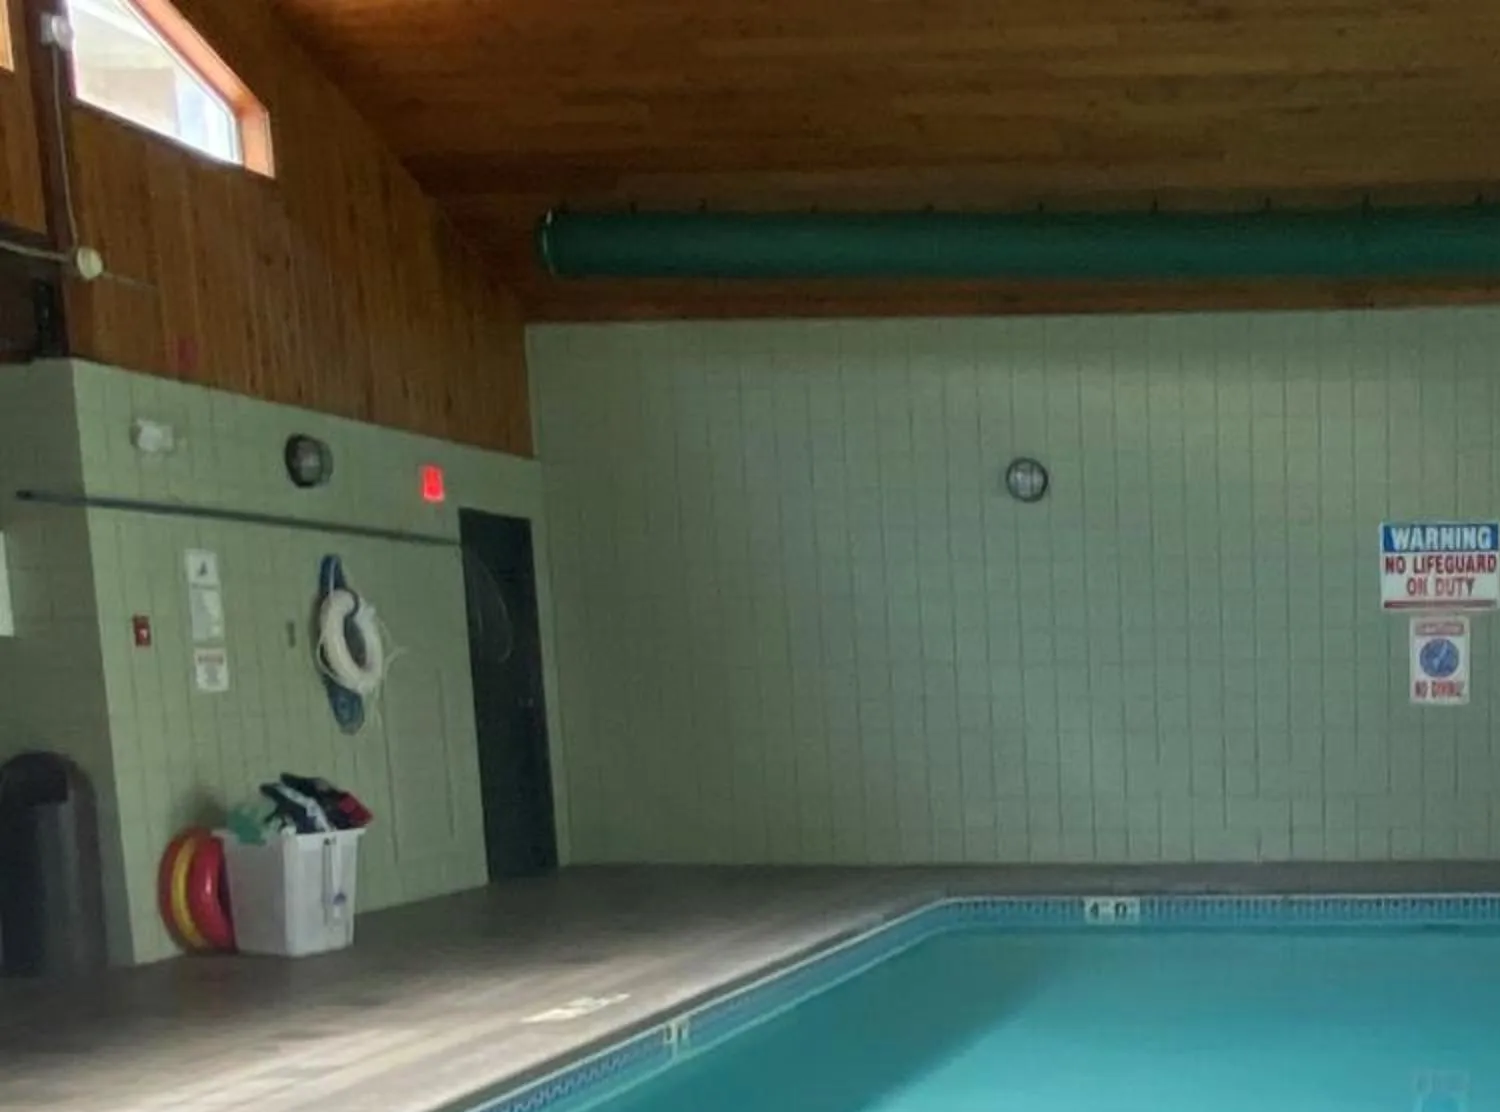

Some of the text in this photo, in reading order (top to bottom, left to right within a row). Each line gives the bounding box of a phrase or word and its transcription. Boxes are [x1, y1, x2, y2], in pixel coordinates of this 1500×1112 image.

[1391, 526, 1492, 550] WARNING
[1385, 554, 1497, 574] NO LIFEGUARD
[1406, 577, 1476, 597] ON DUTY
